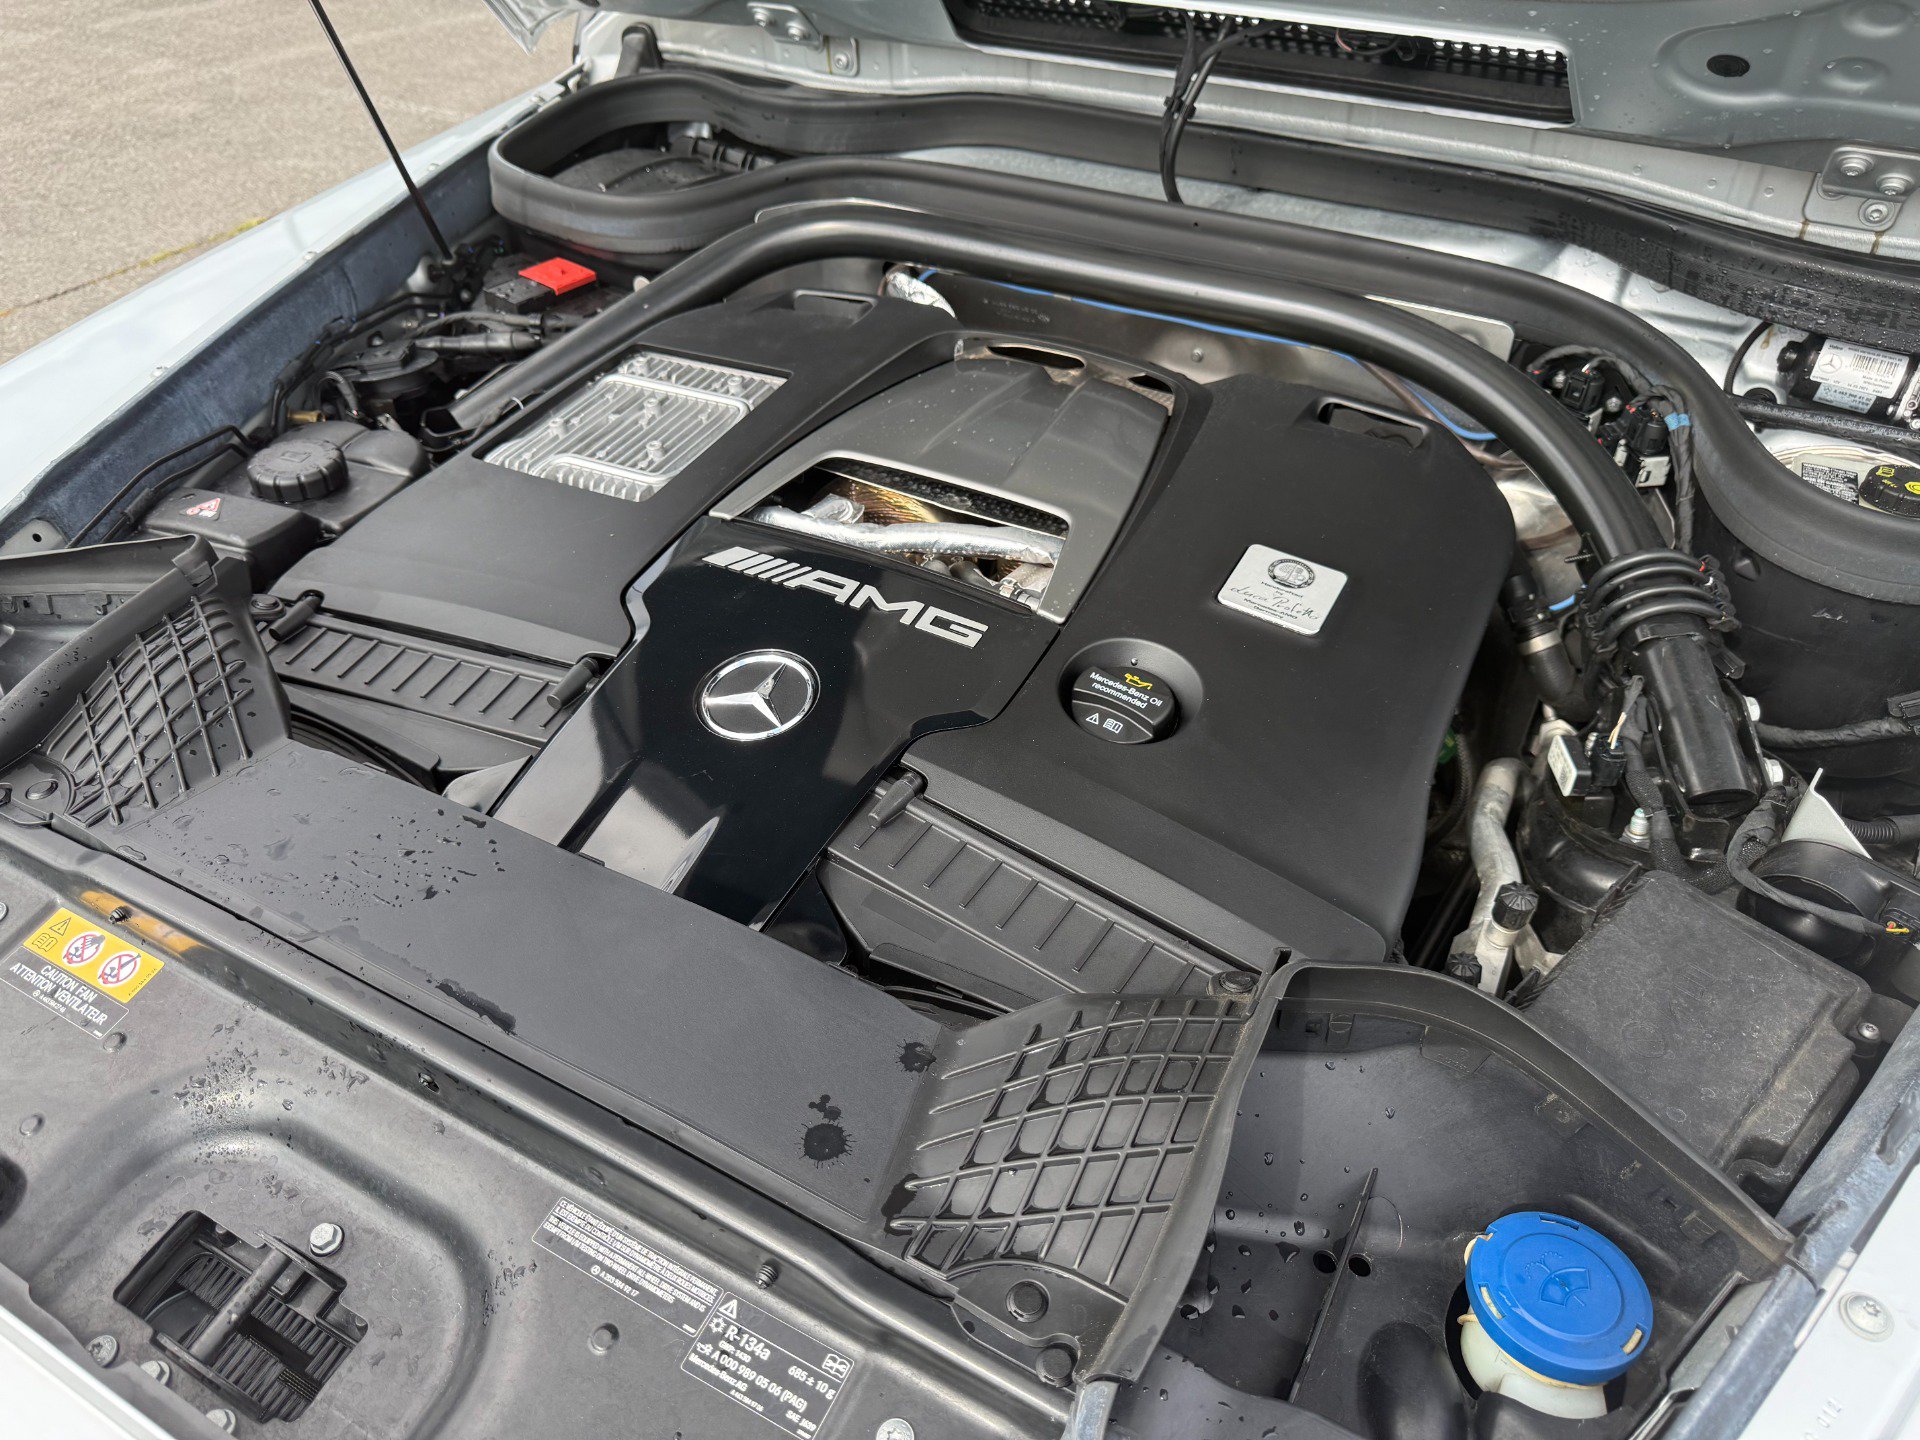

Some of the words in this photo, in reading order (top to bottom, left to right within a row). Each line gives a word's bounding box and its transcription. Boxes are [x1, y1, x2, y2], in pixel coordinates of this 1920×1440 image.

[783, 569, 989, 648] AMG
[1090, 672, 1149, 701] Mercedes-Benz
[1150, 697, 1163, 707] Oil
[1092, 682, 1147, 709] recommended
[9, 961, 56, 993] ATTENTION
[52, 988, 108, 1024] VENTILATEUR
[39, 964, 78, 991] CAUTION
[75, 986, 97, 1002] FAN
[543, 1222, 560, 1234] EXEMPT
[559, 1231, 572, 1242] FROM
[579, 1243, 596, 1256] TESTING
[612, 1263, 626, 1274] WHEEL
[626, 1271, 640, 1283] DRIVE
[558, 1221, 575, 1235] VEHICLE
[578, 1234, 599, 1249] EQUIPPED
[598, 1246, 610, 1255] WITH
[612, 1254, 637, 1272] PERMANENT
[659, 1282, 673, 1293] DRIVE
[672, 1289, 690, 1303] SYSTEM
[630, 1289, 639, 1297] 17
[724, 1325, 772, 1360] R-134a
[688, 1353, 737, 1385] Mercedes-Benz
[735, 1380, 748, 1391] AG
[711, 1350, 720, 1360] A
[718, 1354, 739, 1370] 000
[737, 1364, 756, 1381] 989
[754, 1375, 769, 1388] 05
[767, 1382, 782, 1395] 06
[779, 1389, 808, 1412] (PAG)
[787, 1364, 808, 1381] 685
[814, 1379, 828, 1393] 10
[825, 1387, 836, 1399] g
[785, 1410, 800, 1422] SAE
